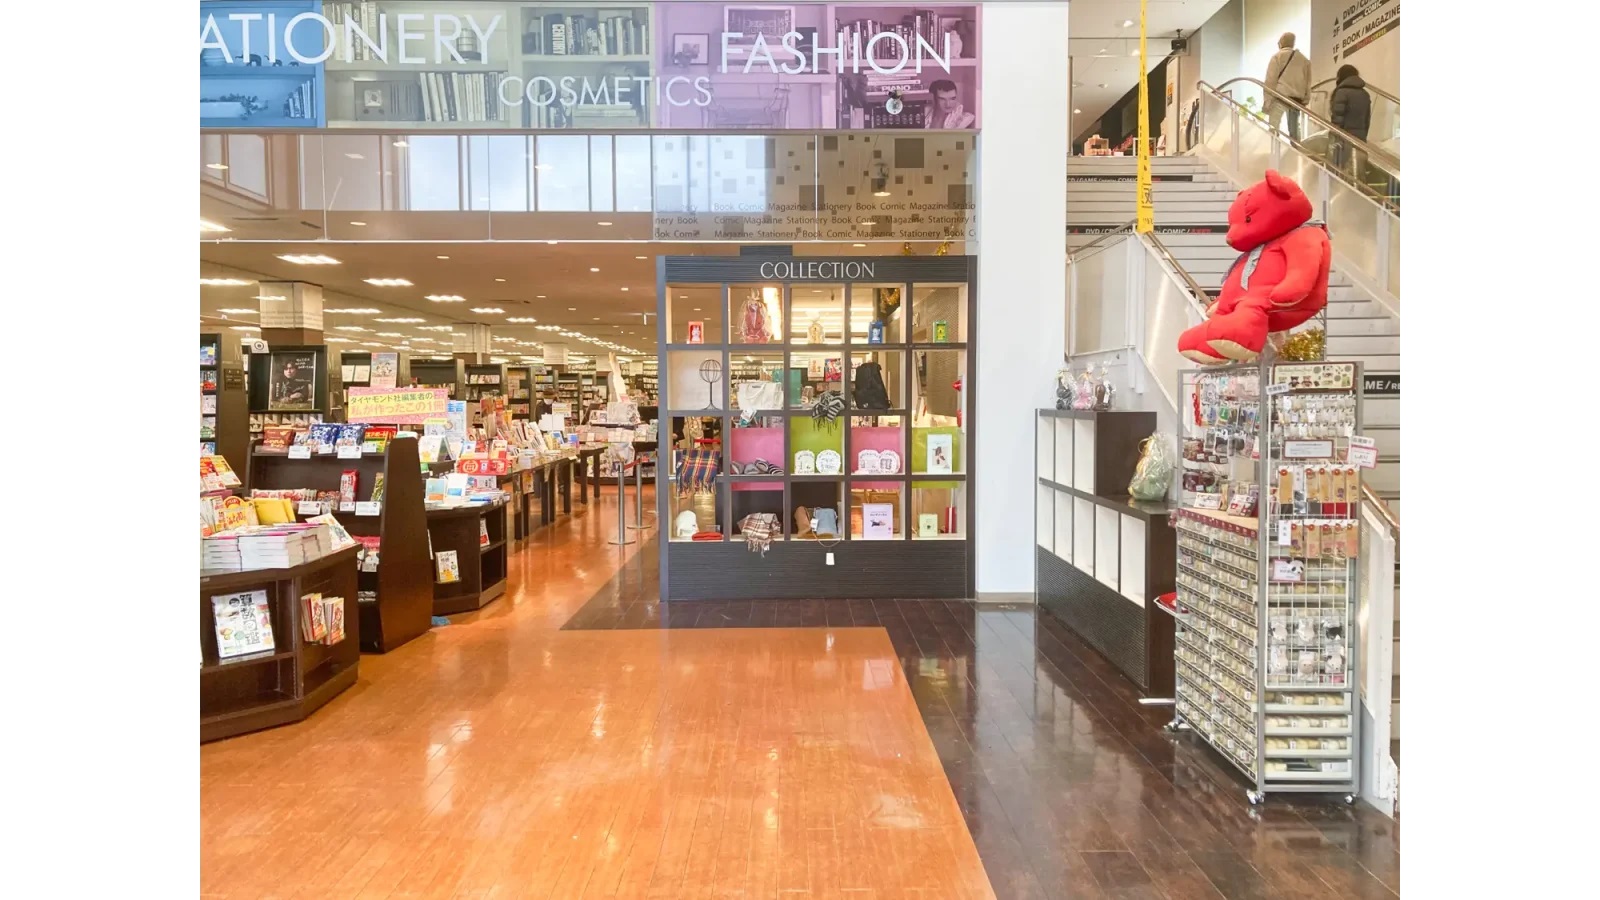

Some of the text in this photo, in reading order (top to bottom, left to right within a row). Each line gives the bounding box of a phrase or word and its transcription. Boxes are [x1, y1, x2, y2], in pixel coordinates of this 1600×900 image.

[720, 31, 951, 75] FASHION
[499, 76, 712, 107] COSMETICS
[714, 202, 735, 211] Book
[738, 202, 764, 211] Comic
[768, 202, 808, 213] Magazine
[811, 202, 854, 213] Stationery
[856, 202, 877, 211] Book
[880, 202, 906, 211] Comic
[909, 202, 949, 213] Magazine
[678, 216, 698, 225] Book
[714, 215, 739, 225] Comic
[744, 215, 783, 226] Magazine
[786, 215, 828, 225] Stationery
[831, 215, 853, 225] Book
[855, 215, 881, 225] Comic
[885, 214, 925, 225] Magazine
[928, 214, 969, 225] Stationery
[714, 229, 754, 241] Magazine
[757, 229, 799, 240] Stationery
[802, 229, 823, 238] Book
[826, 229, 852, 238] Comic
[856, 229, 896, 240] Magazine
[899, 228, 941, 239] Stationery
[760, 261, 875, 279] COLLECTION
